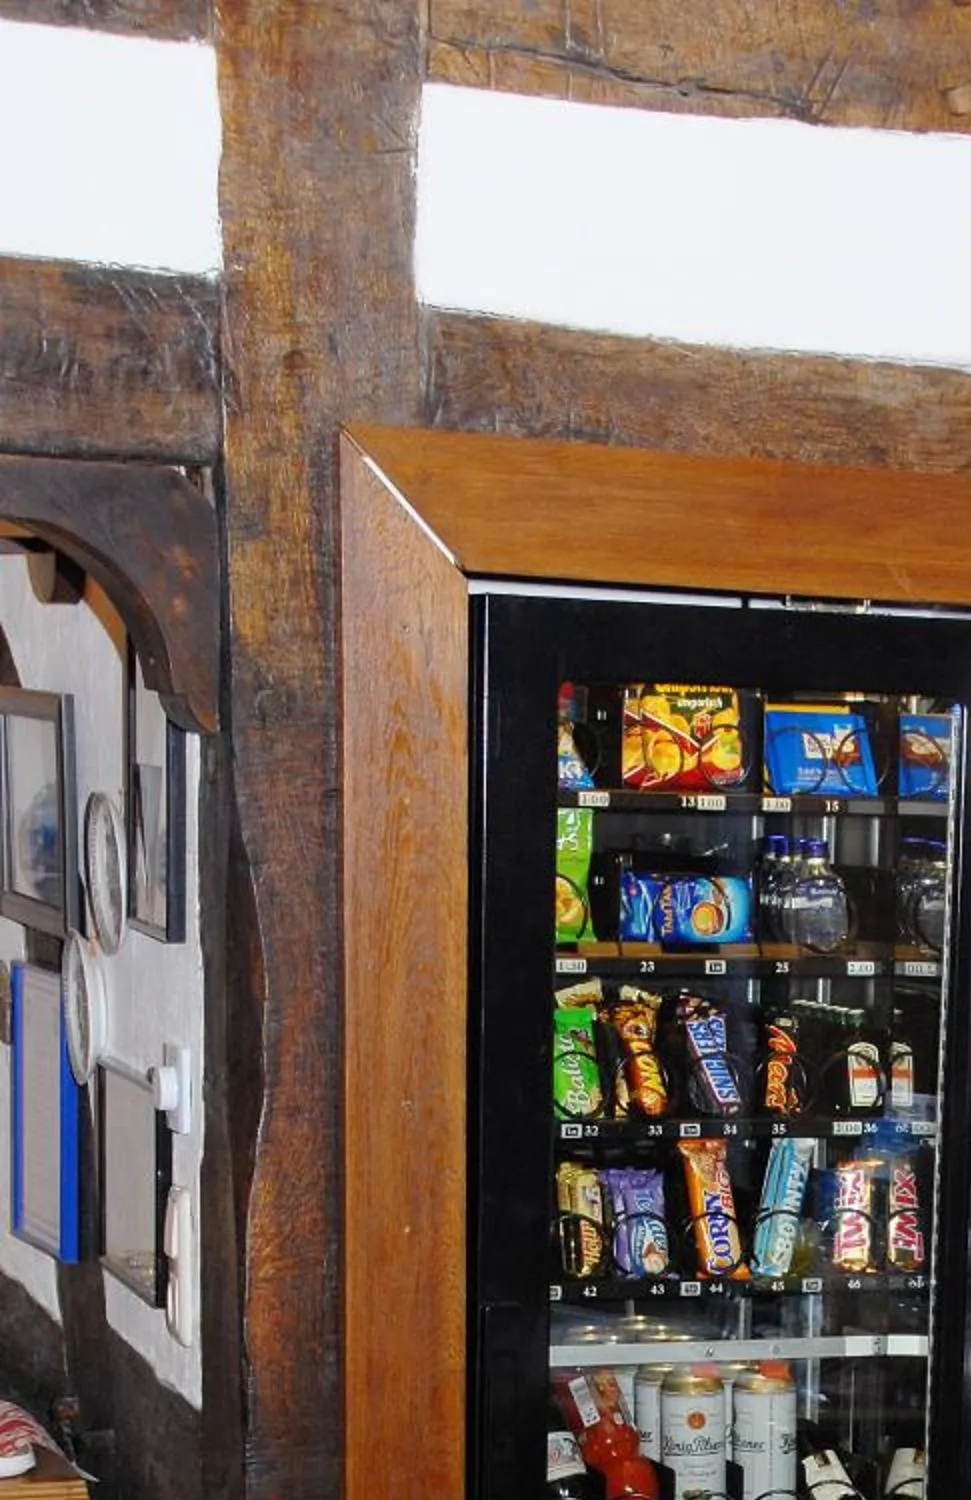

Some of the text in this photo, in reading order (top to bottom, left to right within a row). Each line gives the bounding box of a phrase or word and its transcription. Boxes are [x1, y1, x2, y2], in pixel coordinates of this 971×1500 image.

[681, 796, 695, 807] 13
[825, 800, 839, 812] 15
[775, 962, 789, 973] 25
[584, 1125, 599, 1137] 32
[648, 1125, 663, 1136] 33
[723, 1124, 738, 1136] 34
[772, 1123, 787, 1135] 35
[770, 1160, 807, 1267] BONTY
[583, 1285, 597, 1297] 42
[650, 1284, 665, 1295] 43
[709, 1283, 723, 1294] 44
[771, 1281, 785, 1292] 45
